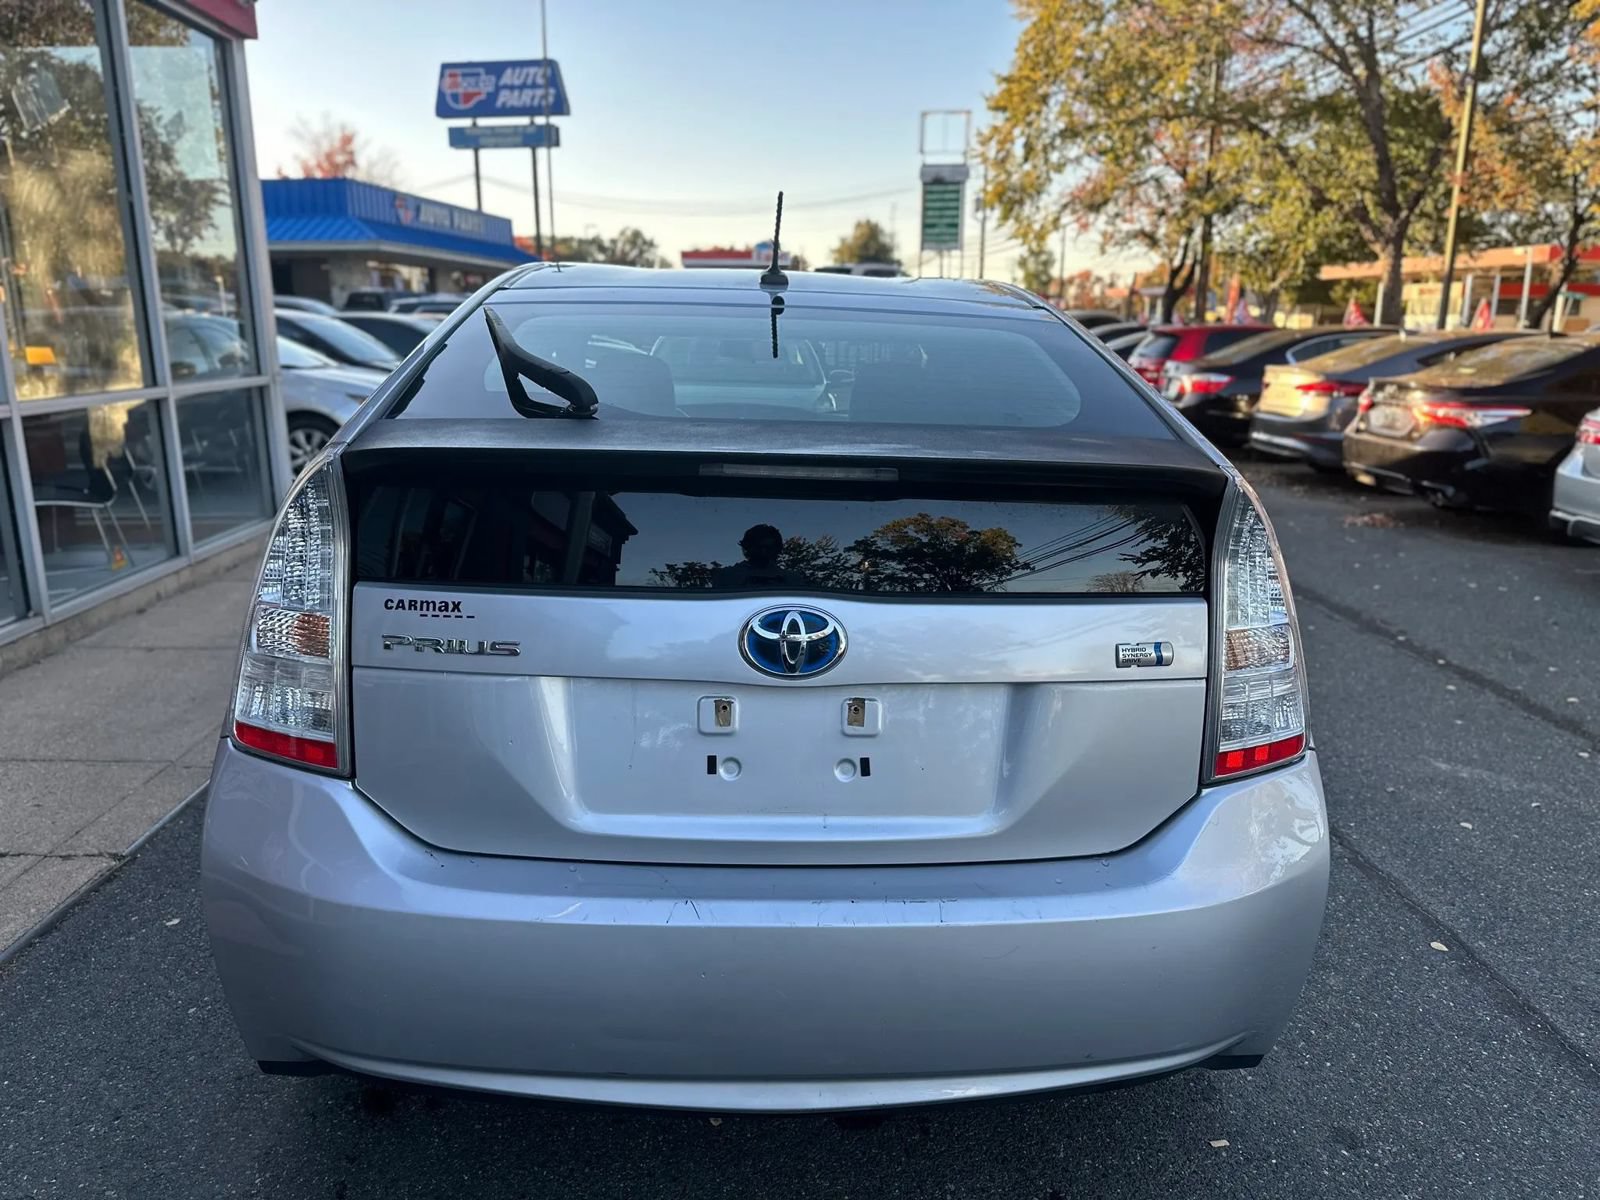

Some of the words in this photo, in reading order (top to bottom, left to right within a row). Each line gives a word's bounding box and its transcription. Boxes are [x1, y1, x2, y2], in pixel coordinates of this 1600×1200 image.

[499, 66, 552, 86] AUTO
[495, 87, 556, 108] PARTS
[381, 634, 521, 656] PRIUS
